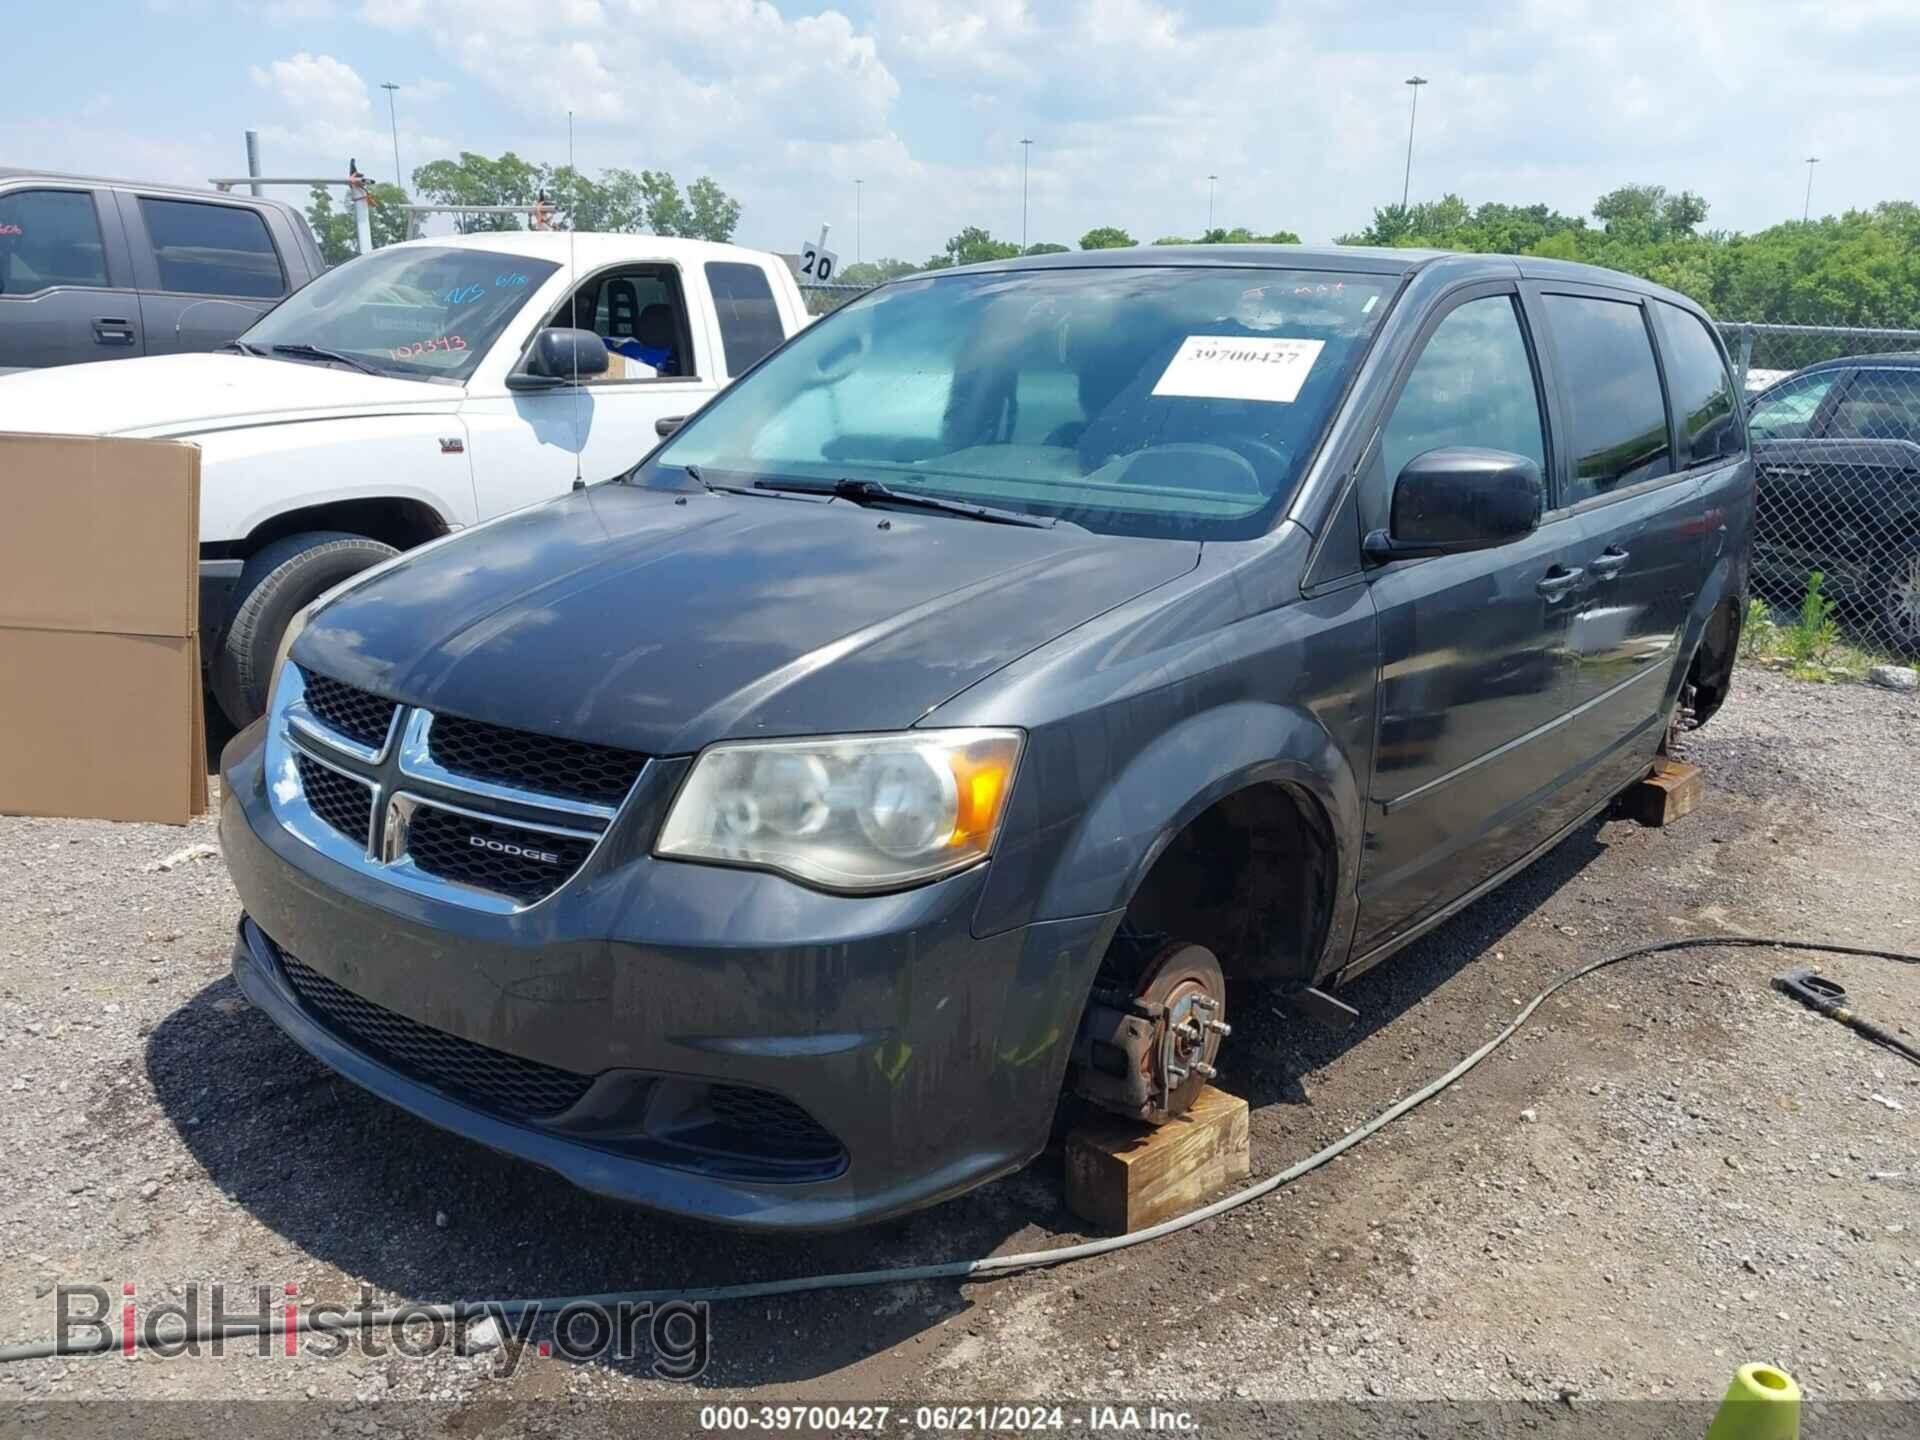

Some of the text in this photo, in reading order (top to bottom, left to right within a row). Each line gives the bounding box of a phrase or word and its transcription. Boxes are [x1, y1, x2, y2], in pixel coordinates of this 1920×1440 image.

[801, 250, 831, 281] 20
[388, 335, 467, 361] 102343
[1187, 349, 1300, 364] 39700427
[469, 836, 559, 864] DODGE
